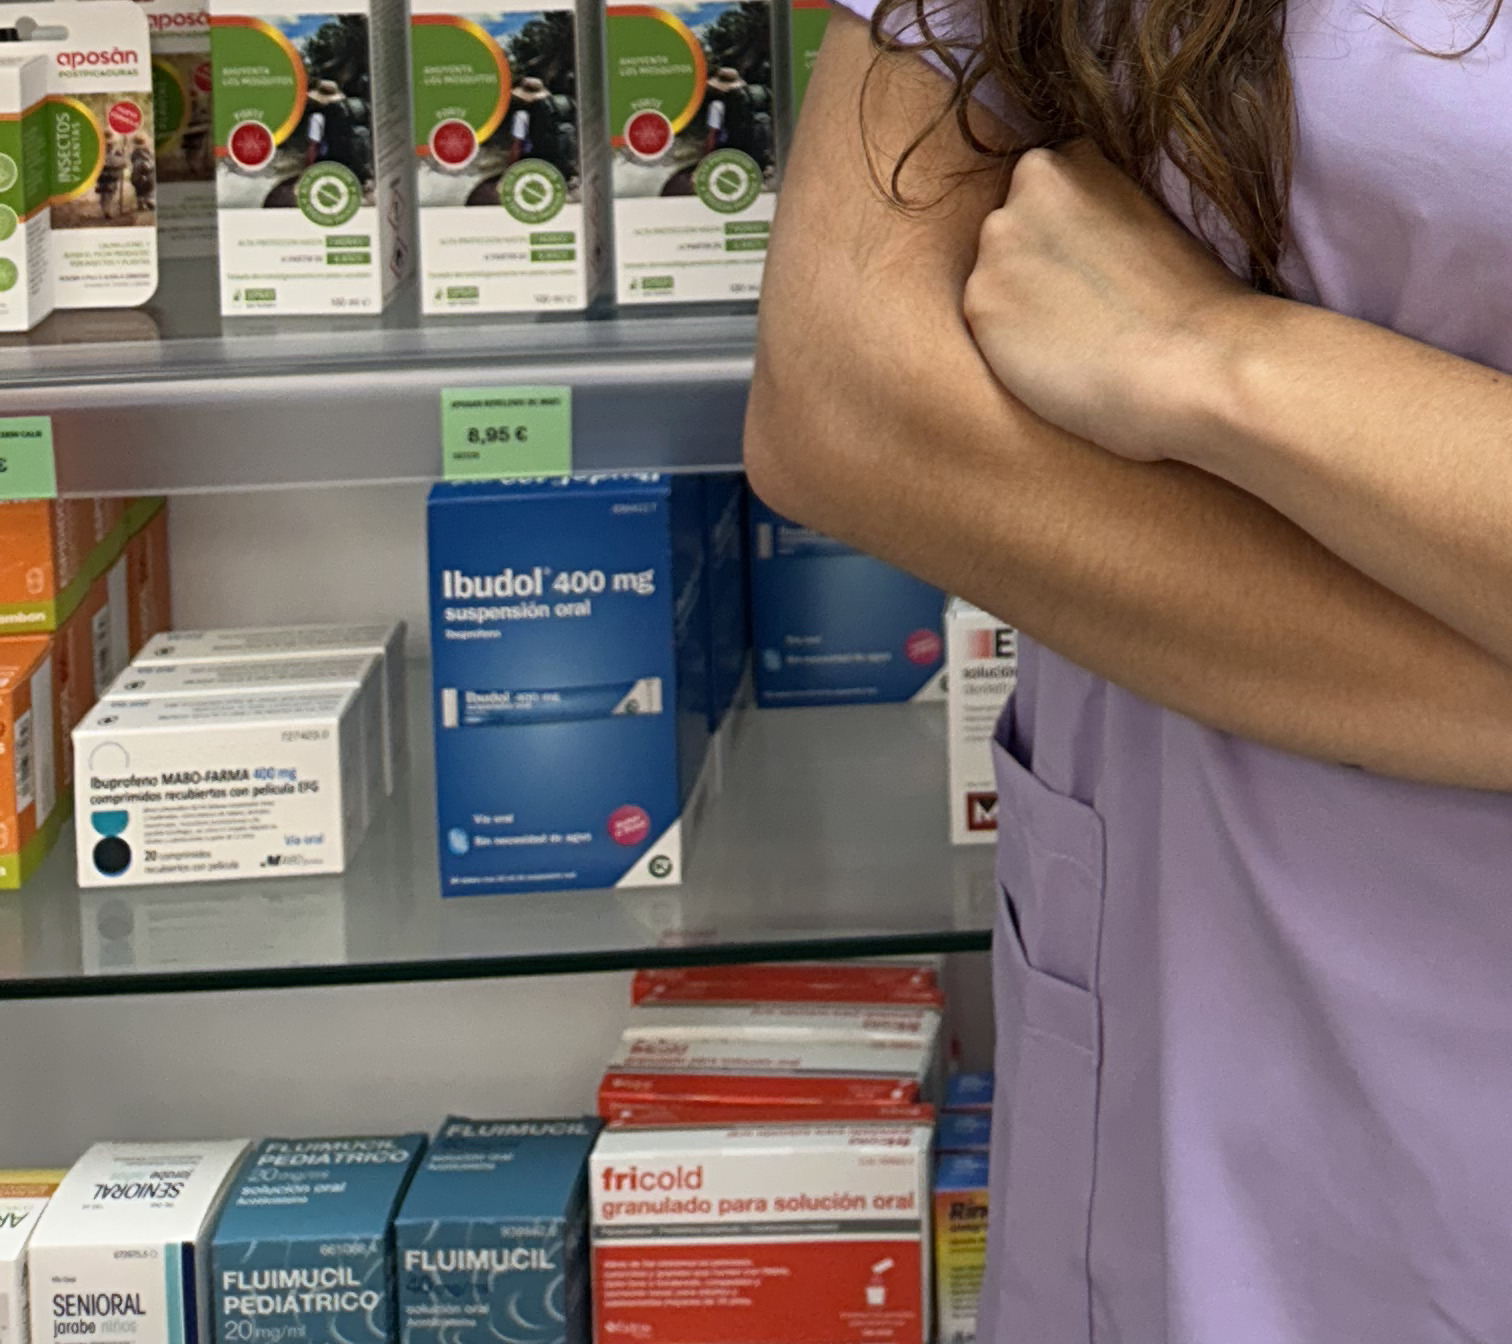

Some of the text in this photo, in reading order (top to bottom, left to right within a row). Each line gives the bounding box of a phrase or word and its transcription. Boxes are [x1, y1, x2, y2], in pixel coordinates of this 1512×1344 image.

[467, 425, 528, 444] 8,95 €
[443, 568, 655, 599] Ibudol 400 mg
[444, 599, 592, 624] suspensión oral
[602, 1166, 702, 1191] fricold
[601, 1193, 914, 1220] granulado para solución oral
[222, 1268, 361, 1290] FLUIMUCIL
[52, 1294, 146, 1317] SENIORAL
[223, 1291, 380, 1314] PEDIÁTRICO
